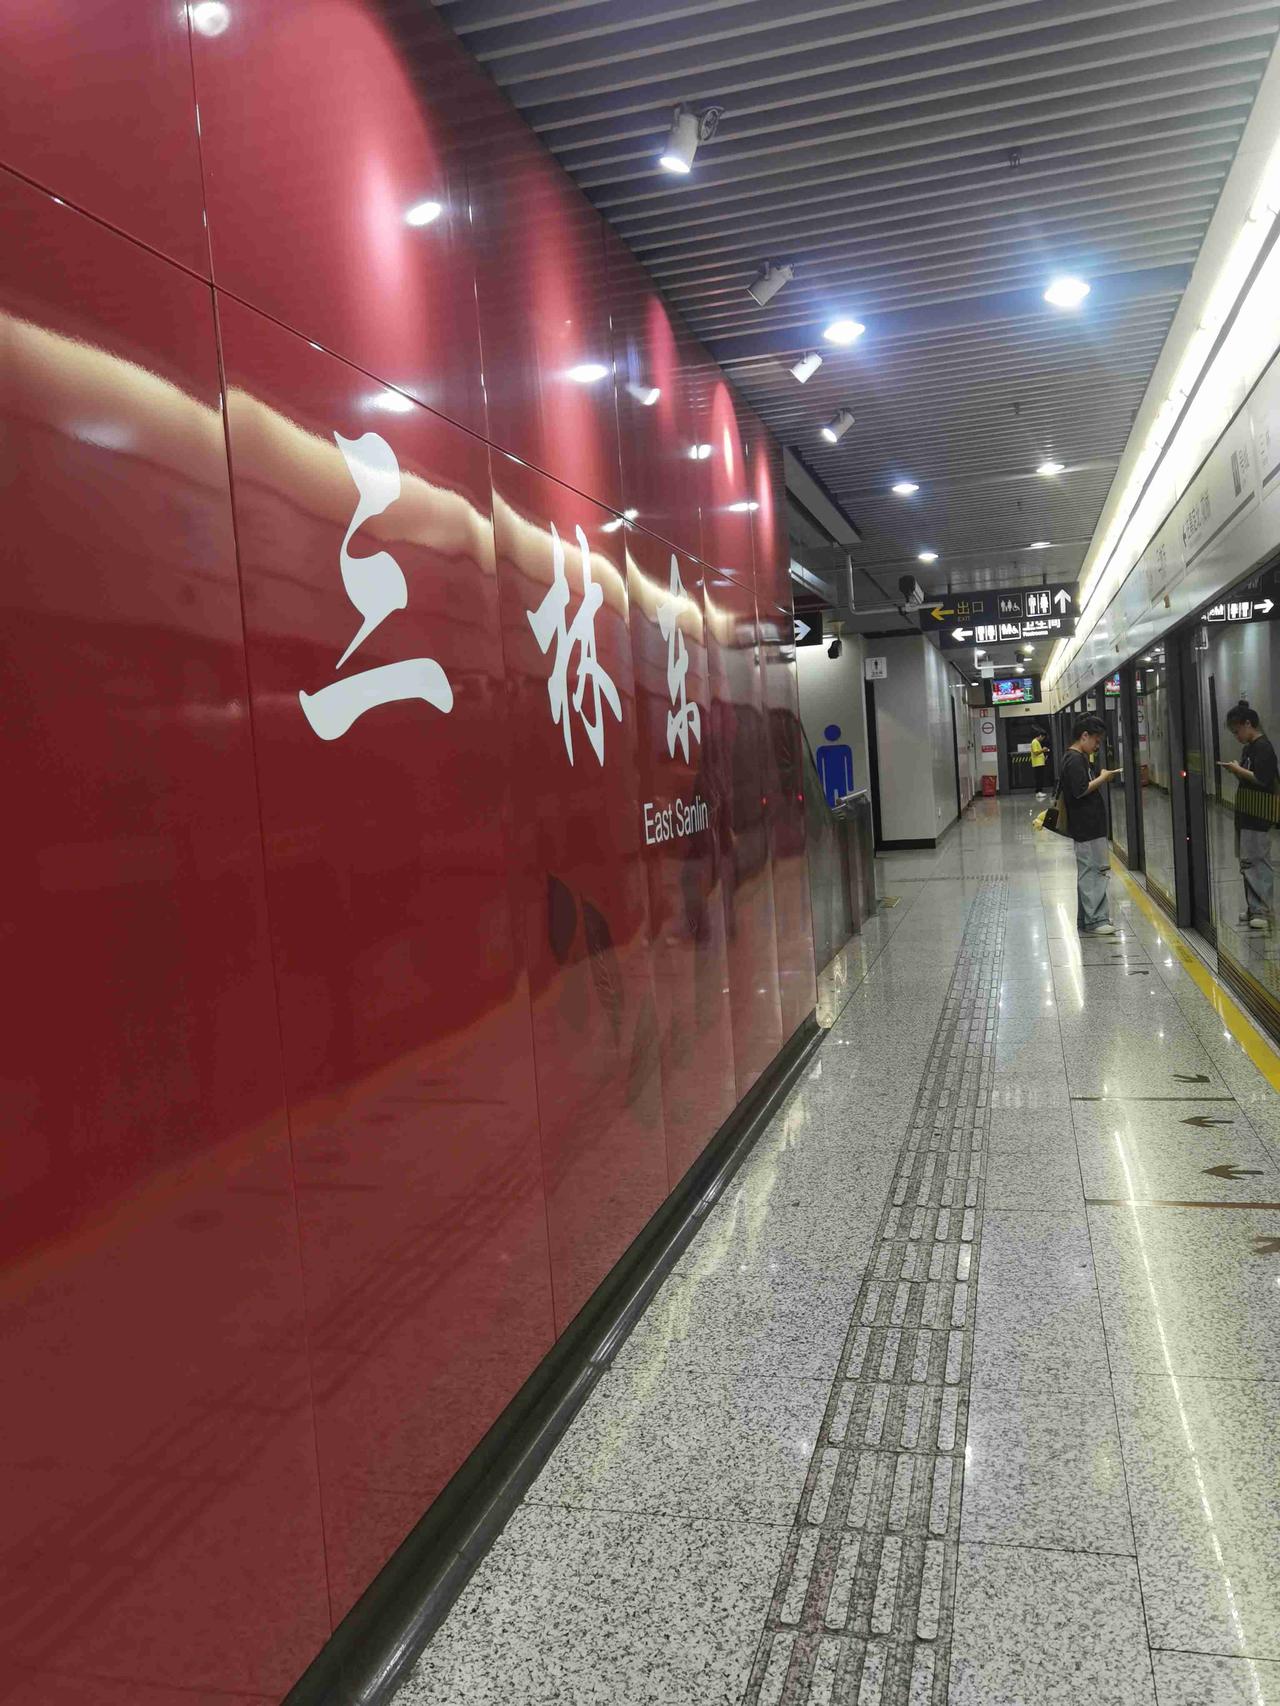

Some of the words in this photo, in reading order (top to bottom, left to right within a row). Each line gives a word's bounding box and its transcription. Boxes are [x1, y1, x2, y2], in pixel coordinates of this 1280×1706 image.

[957, 600, 984, 615] 出口
[1022, 618, 1061, 631] 卫生间
[644, 803, 674, 845] East
[676, 795, 708, 837] Sanlin
